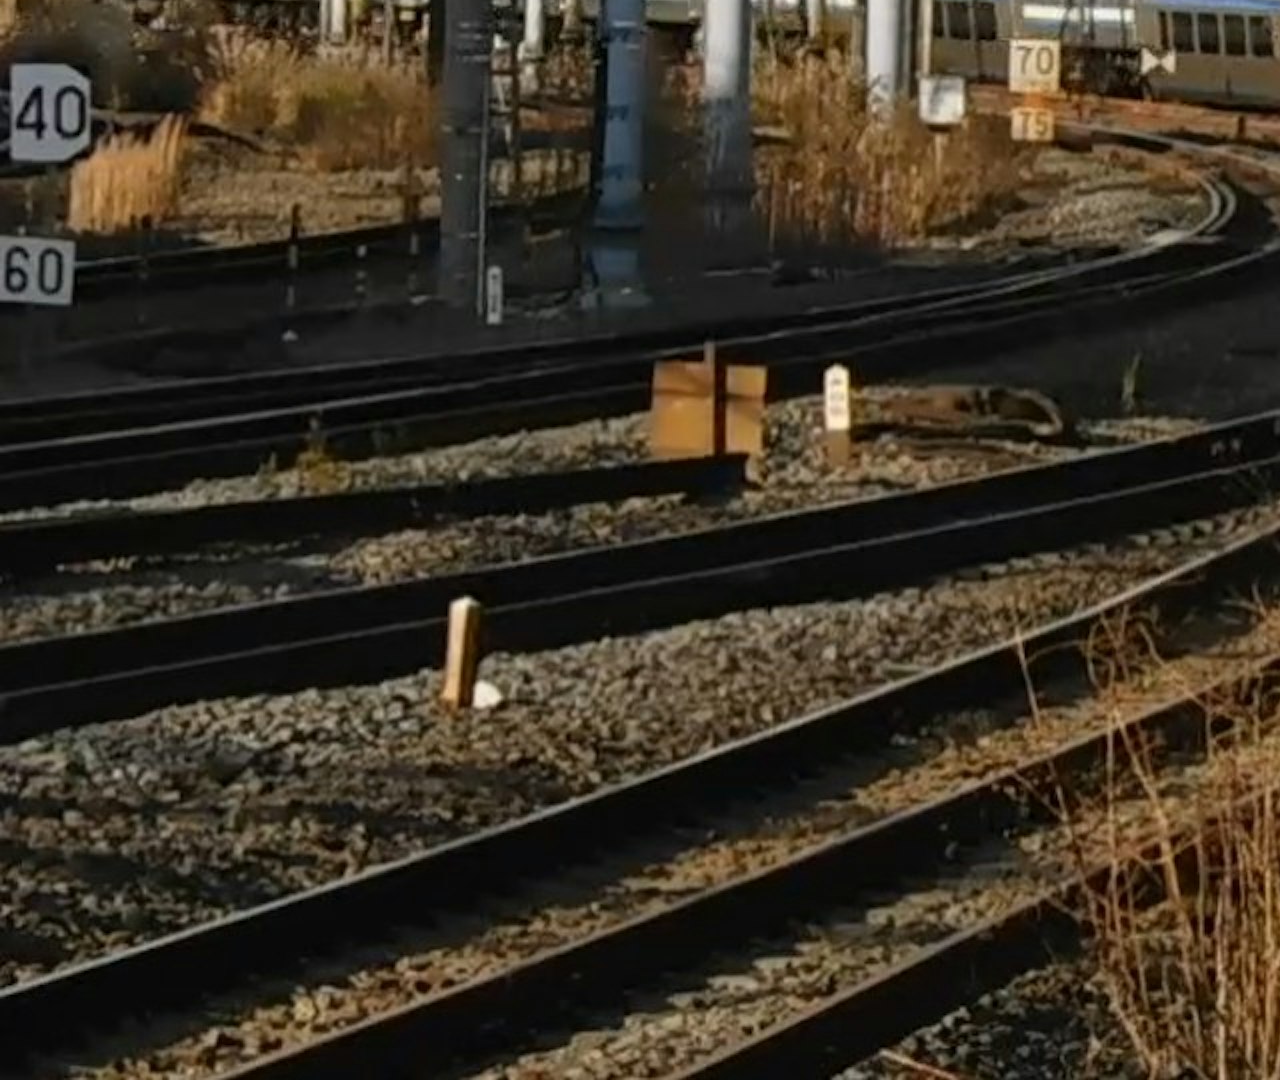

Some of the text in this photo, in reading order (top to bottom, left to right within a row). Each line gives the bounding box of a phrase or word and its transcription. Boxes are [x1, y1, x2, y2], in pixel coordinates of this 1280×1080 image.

[1016, 46, 1054, 75] 70
[16, 85, 87, 141] 40
[1018, 111, 1049, 136] 75
[4, 245, 63, 296] 60
